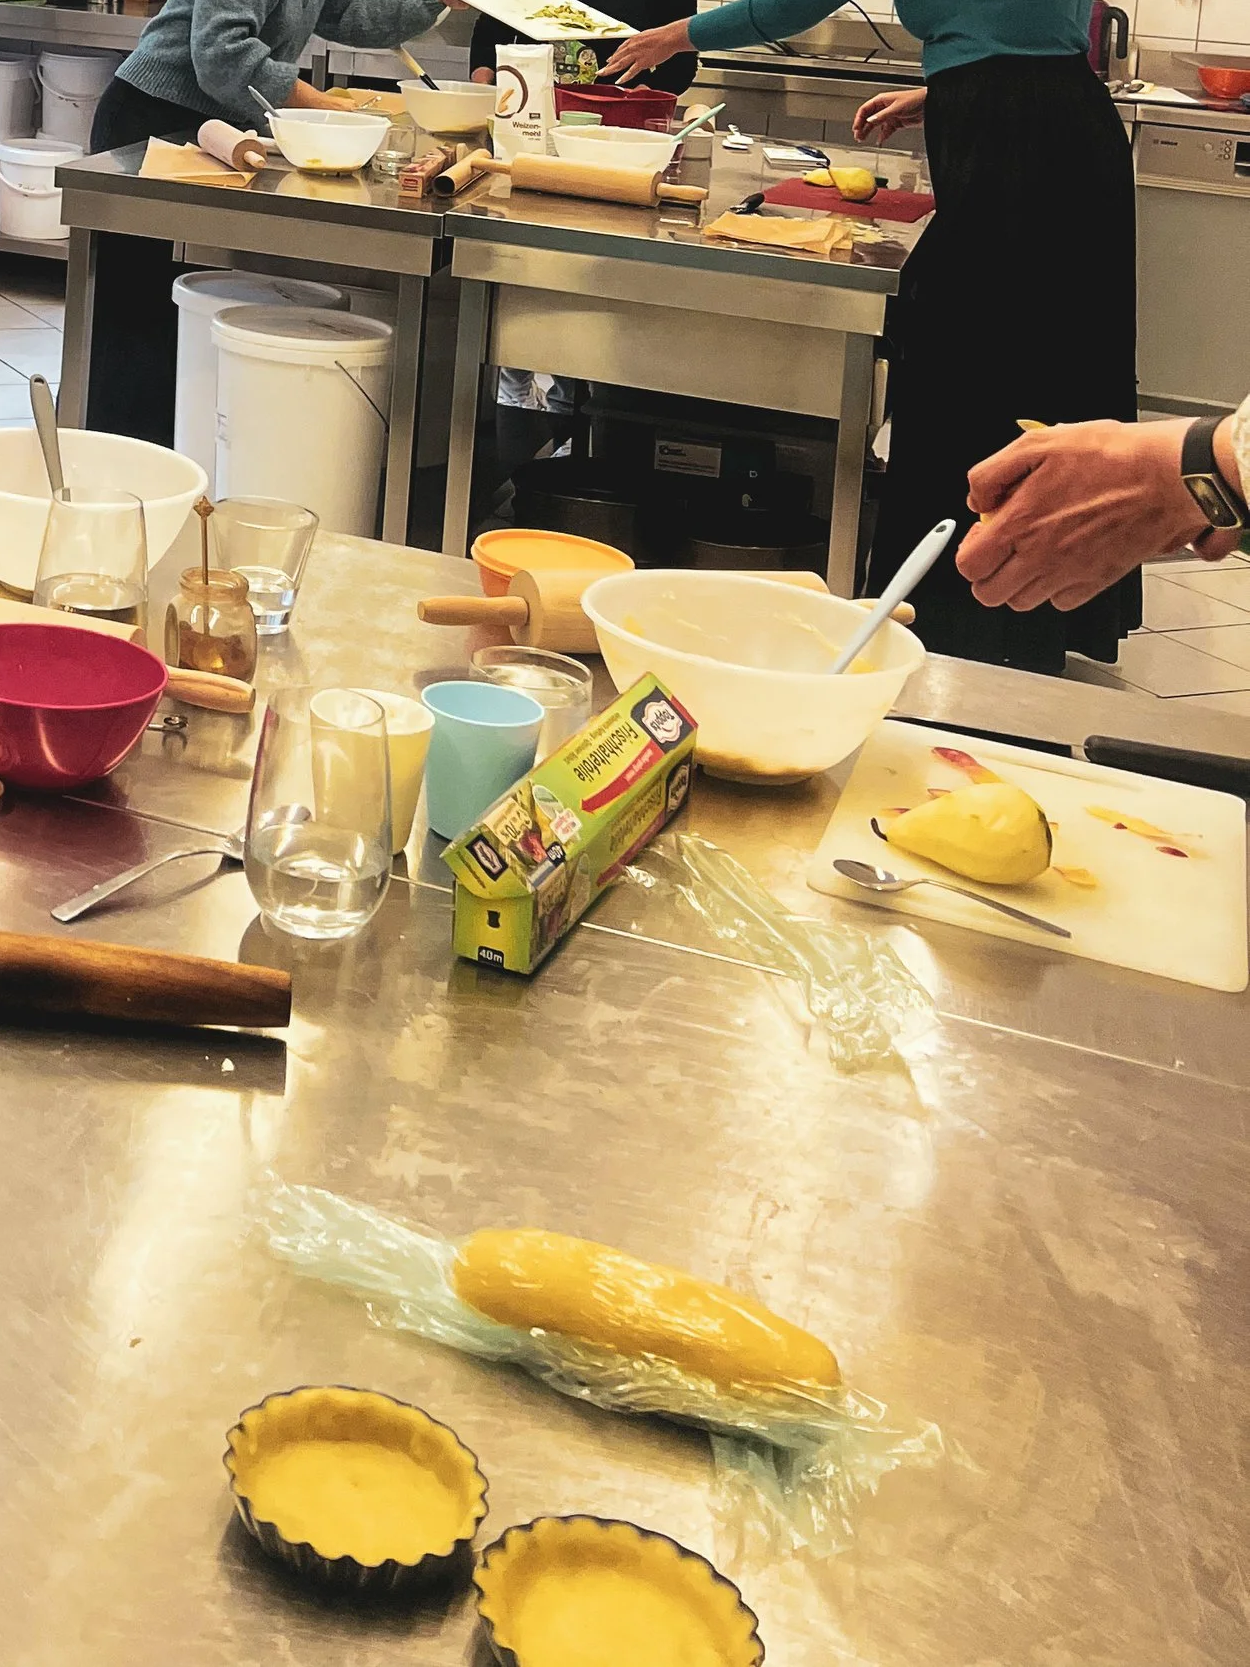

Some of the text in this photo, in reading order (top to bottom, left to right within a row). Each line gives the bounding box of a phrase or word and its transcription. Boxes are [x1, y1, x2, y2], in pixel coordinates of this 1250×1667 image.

[512, 121, 541, 129] Weizen-
[650, 708, 676, 732] Toppits
[573, 721, 639, 782] Frischhaltefolie
[547, 844, 563, 860] 40m
[479, 948, 503, 964] 40m
